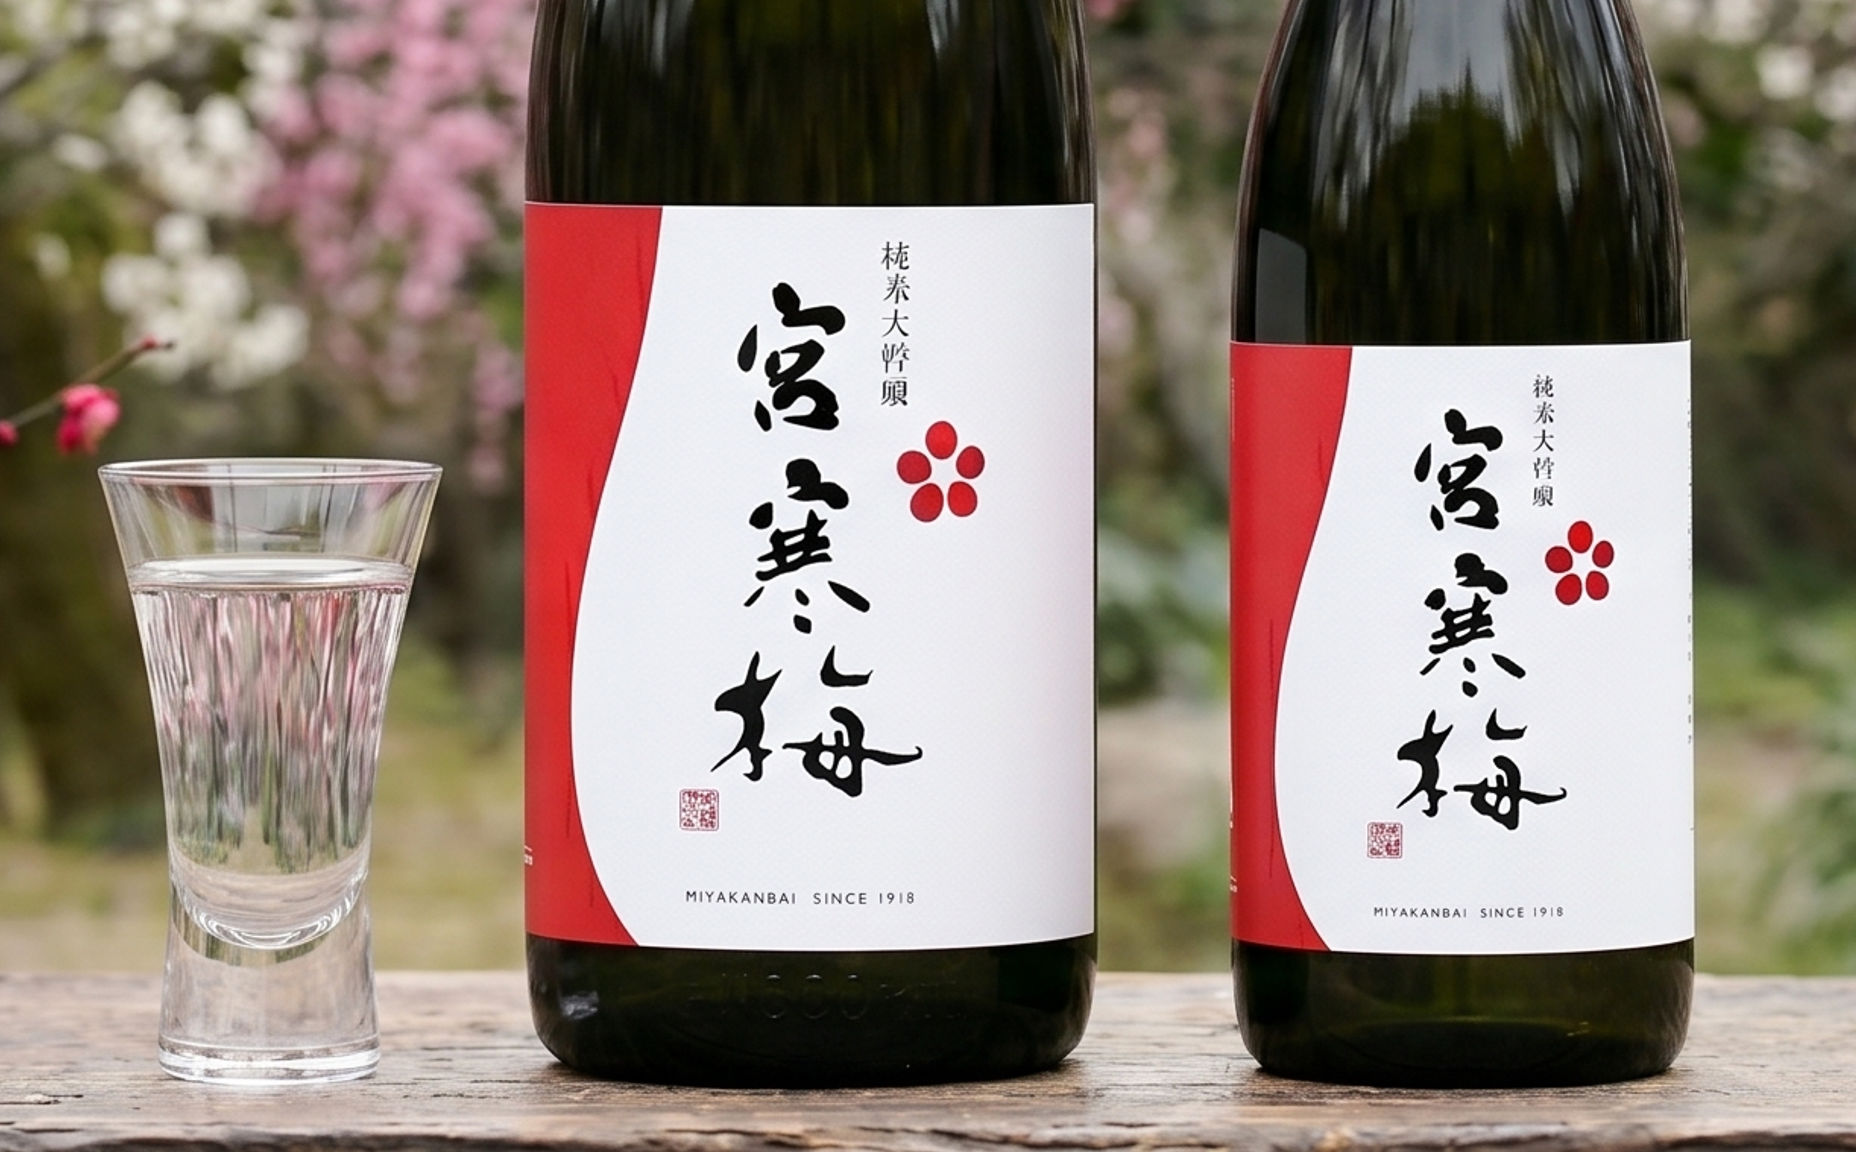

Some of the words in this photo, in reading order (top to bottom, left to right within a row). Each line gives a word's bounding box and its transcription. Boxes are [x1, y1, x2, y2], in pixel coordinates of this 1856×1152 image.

[711, 282, 923, 797] 宮寒梅
[1397, 408, 1567, 831] 宮寒梅
[685, 890, 796, 905] MIYAKANBAI
[812, 892, 868, 905] SINCE
[879, 891, 915, 905] 1918
[1373, 906, 1467, 919] MIYAKANBAI
[1480, 906, 1525, 919] SINCE
[1533, 906, 1564, 918] 1918
